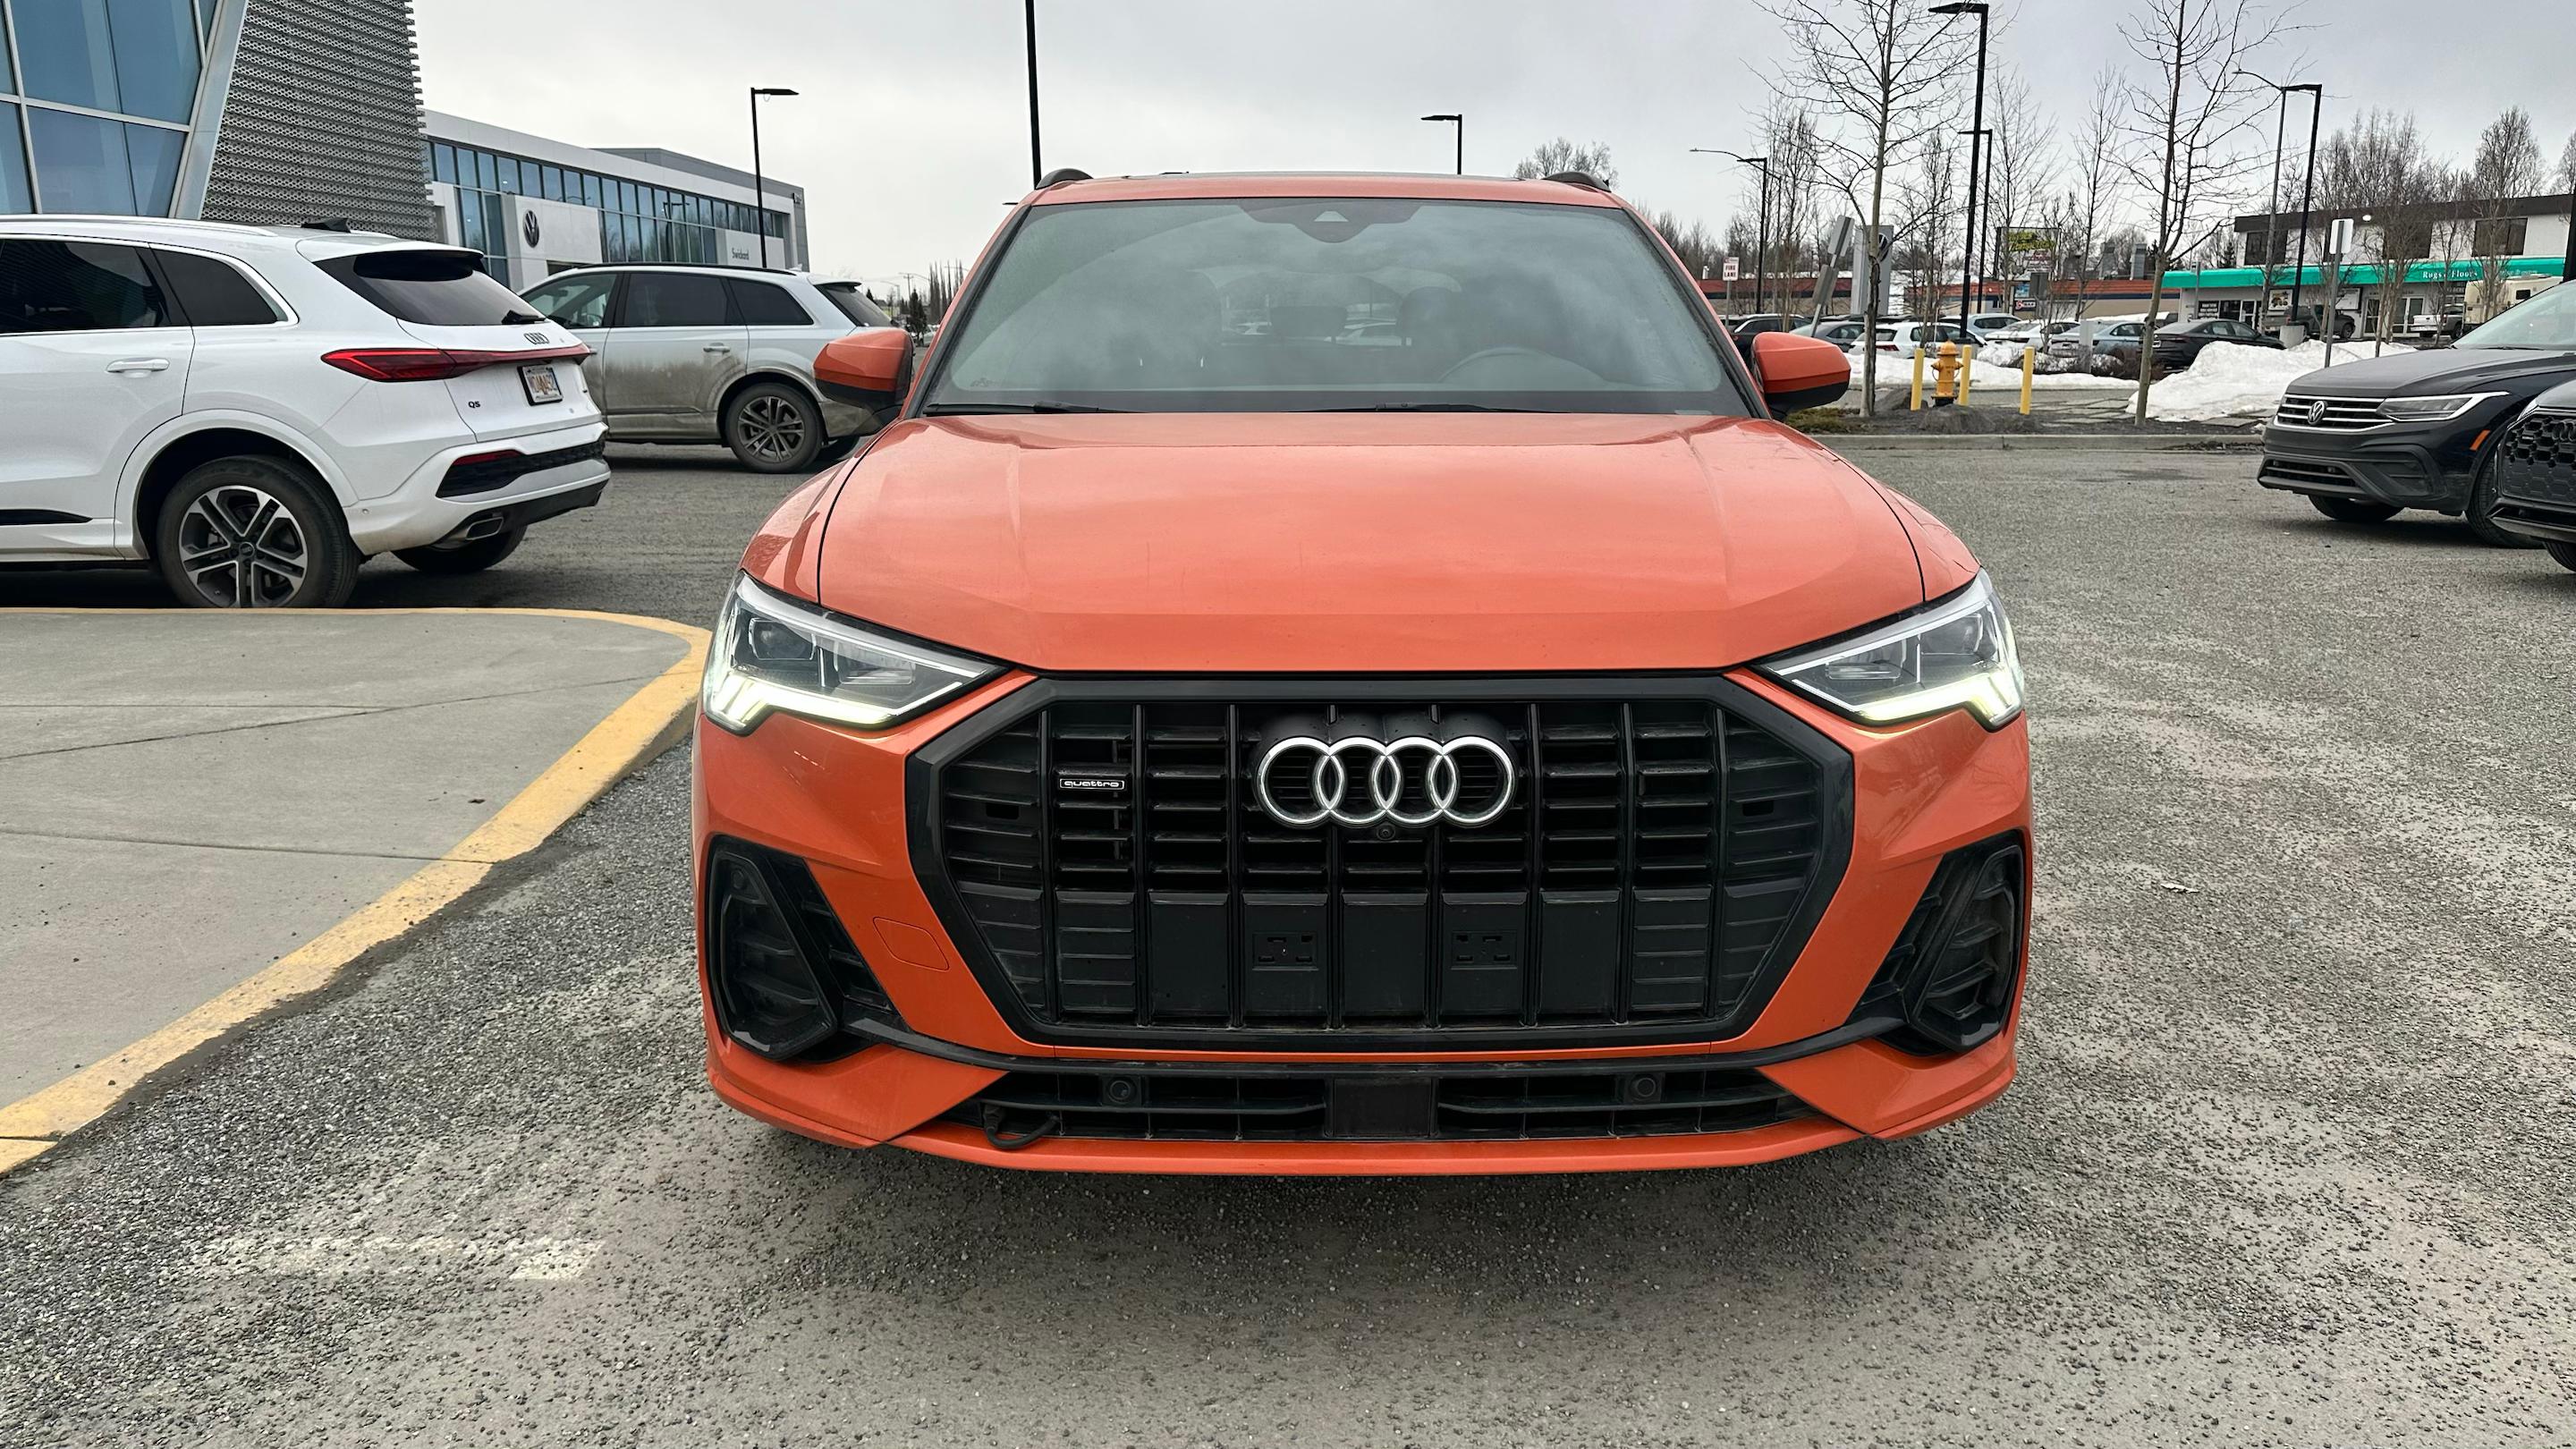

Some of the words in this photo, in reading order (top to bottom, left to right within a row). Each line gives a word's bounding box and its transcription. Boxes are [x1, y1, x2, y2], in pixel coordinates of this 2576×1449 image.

[2422, 270, 2442, 280] Rugs
[2451, 269, 2479, 278] Floors
[468, 401, 481, 409] Q5
[1063, 780, 1120, 788] quattro
